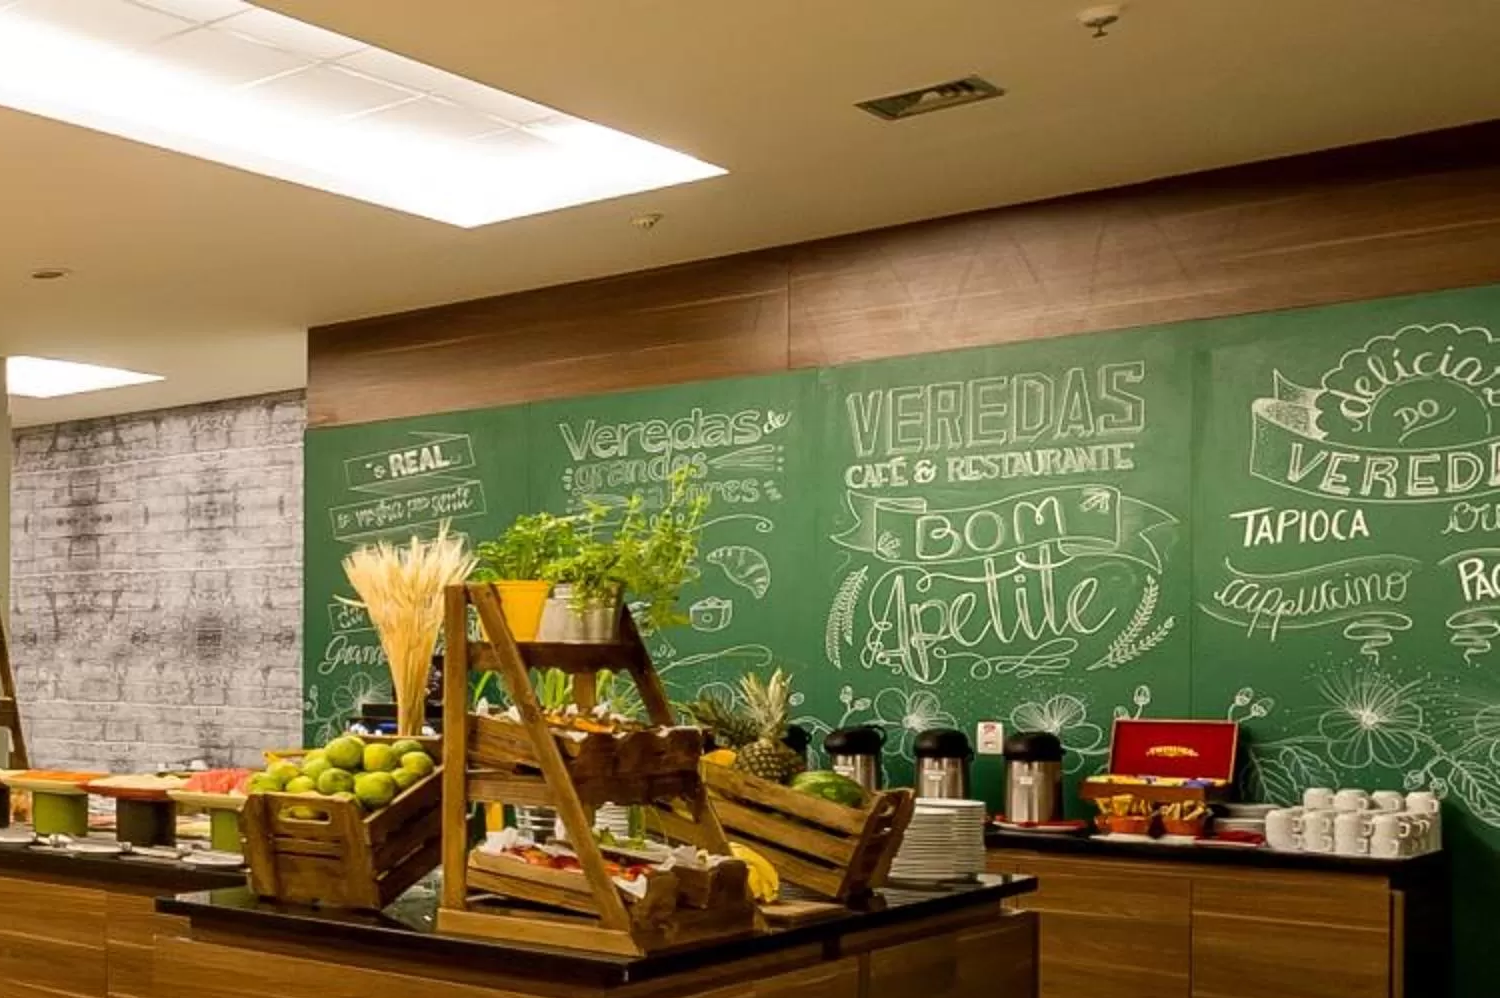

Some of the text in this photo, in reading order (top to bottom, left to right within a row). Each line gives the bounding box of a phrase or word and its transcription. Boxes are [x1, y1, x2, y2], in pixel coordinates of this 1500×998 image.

[559, 407, 763, 461] Veredas
[846, 360, 1146, 458] VEREDAS
[1393, 399, 1439, 430] DO
[844, 442, 1136, 489] CAFÉ & RESTAURANTE
[915, 496, 1066, 560] BOM
[1229, 507, 1370, 548] TAPIOCA
[862, 543, 1117, 685] Apetite
